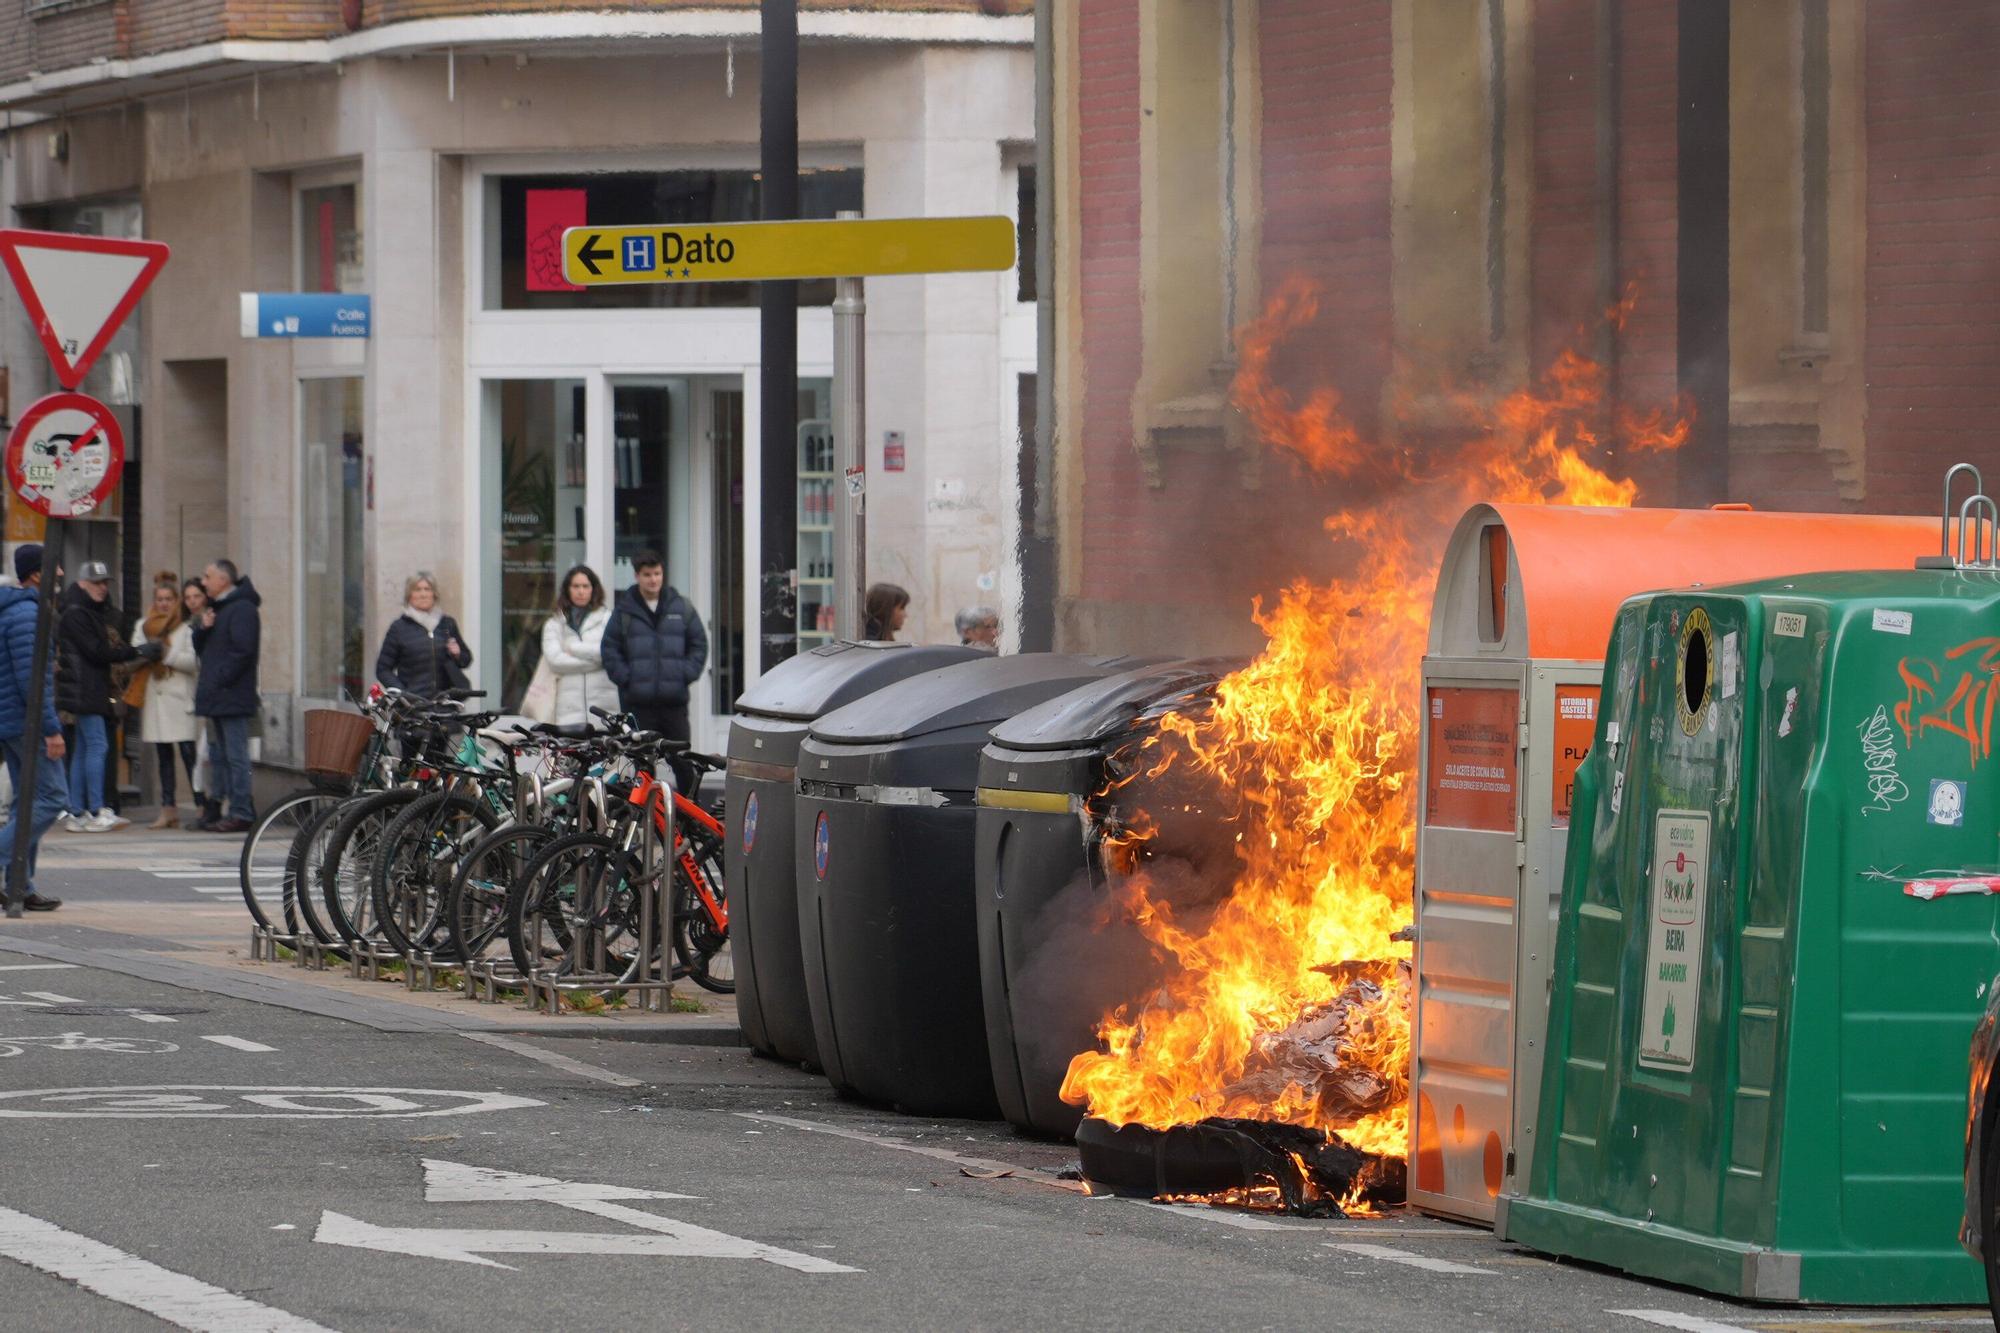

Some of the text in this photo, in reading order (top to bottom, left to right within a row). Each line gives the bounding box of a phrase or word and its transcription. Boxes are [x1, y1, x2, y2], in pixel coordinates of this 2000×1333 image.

[662, 232, 735, 264] Dato
[336, 308, 366, 321] Calle
[1679, 613, 1695, 662] SOLO
[1560, 697, 1587, 706] VITORIA
[1560, 705, 1587, 714] GASTEIZ
[1665, 929, 1685, 952] BEIRA
[1659, 962, 1687, 982] BAKARRIK
